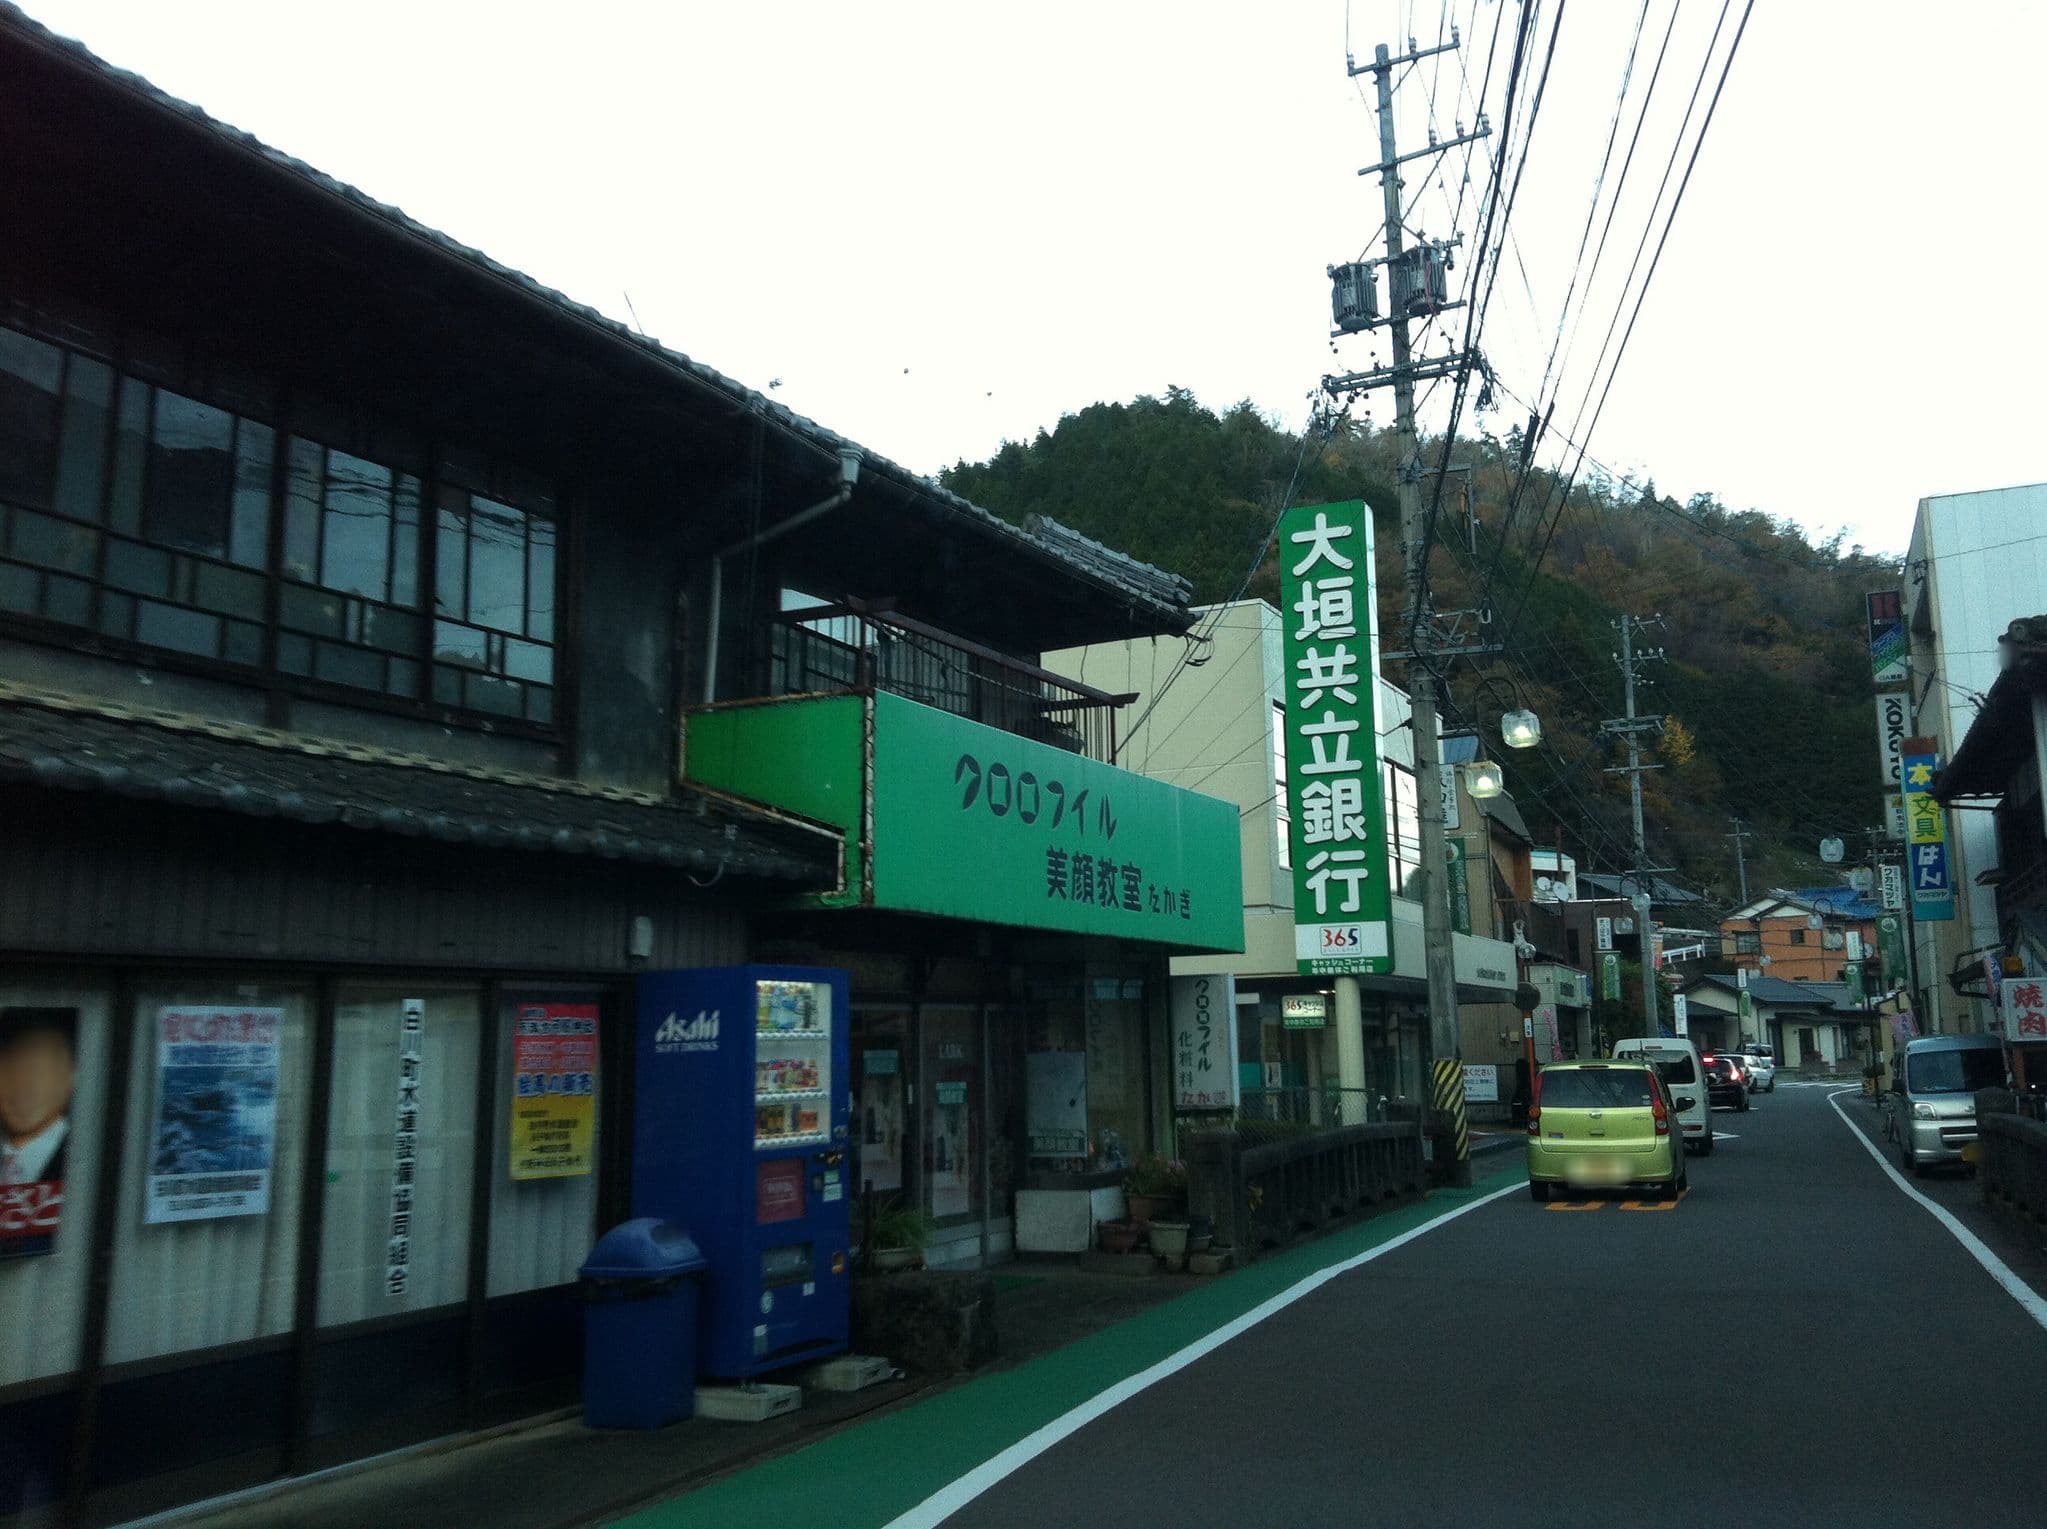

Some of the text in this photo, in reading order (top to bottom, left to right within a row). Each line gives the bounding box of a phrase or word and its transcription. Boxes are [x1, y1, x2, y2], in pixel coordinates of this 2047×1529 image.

[1291, 512, 1369, 915] 大垣共立銀行
[1907, 761, 1934, 786] 本
[1912, 796, 1938, 838] 文具
[1046, 846, 1192, 921] 美顔教室 たかぎ
[1917, 844, 1943, 888] はん
[1323, 927, 1359, 947] 365
[1311, 958, 1374, 967] キャッシュコーナー
[1286, 999, 1302, 1010] 365
[2013, 983, 2047, 1037] 焼肉
[655, 1010, 720, 1042] Asahi
[1178, 1030, 1194, 1088] 化粧料
